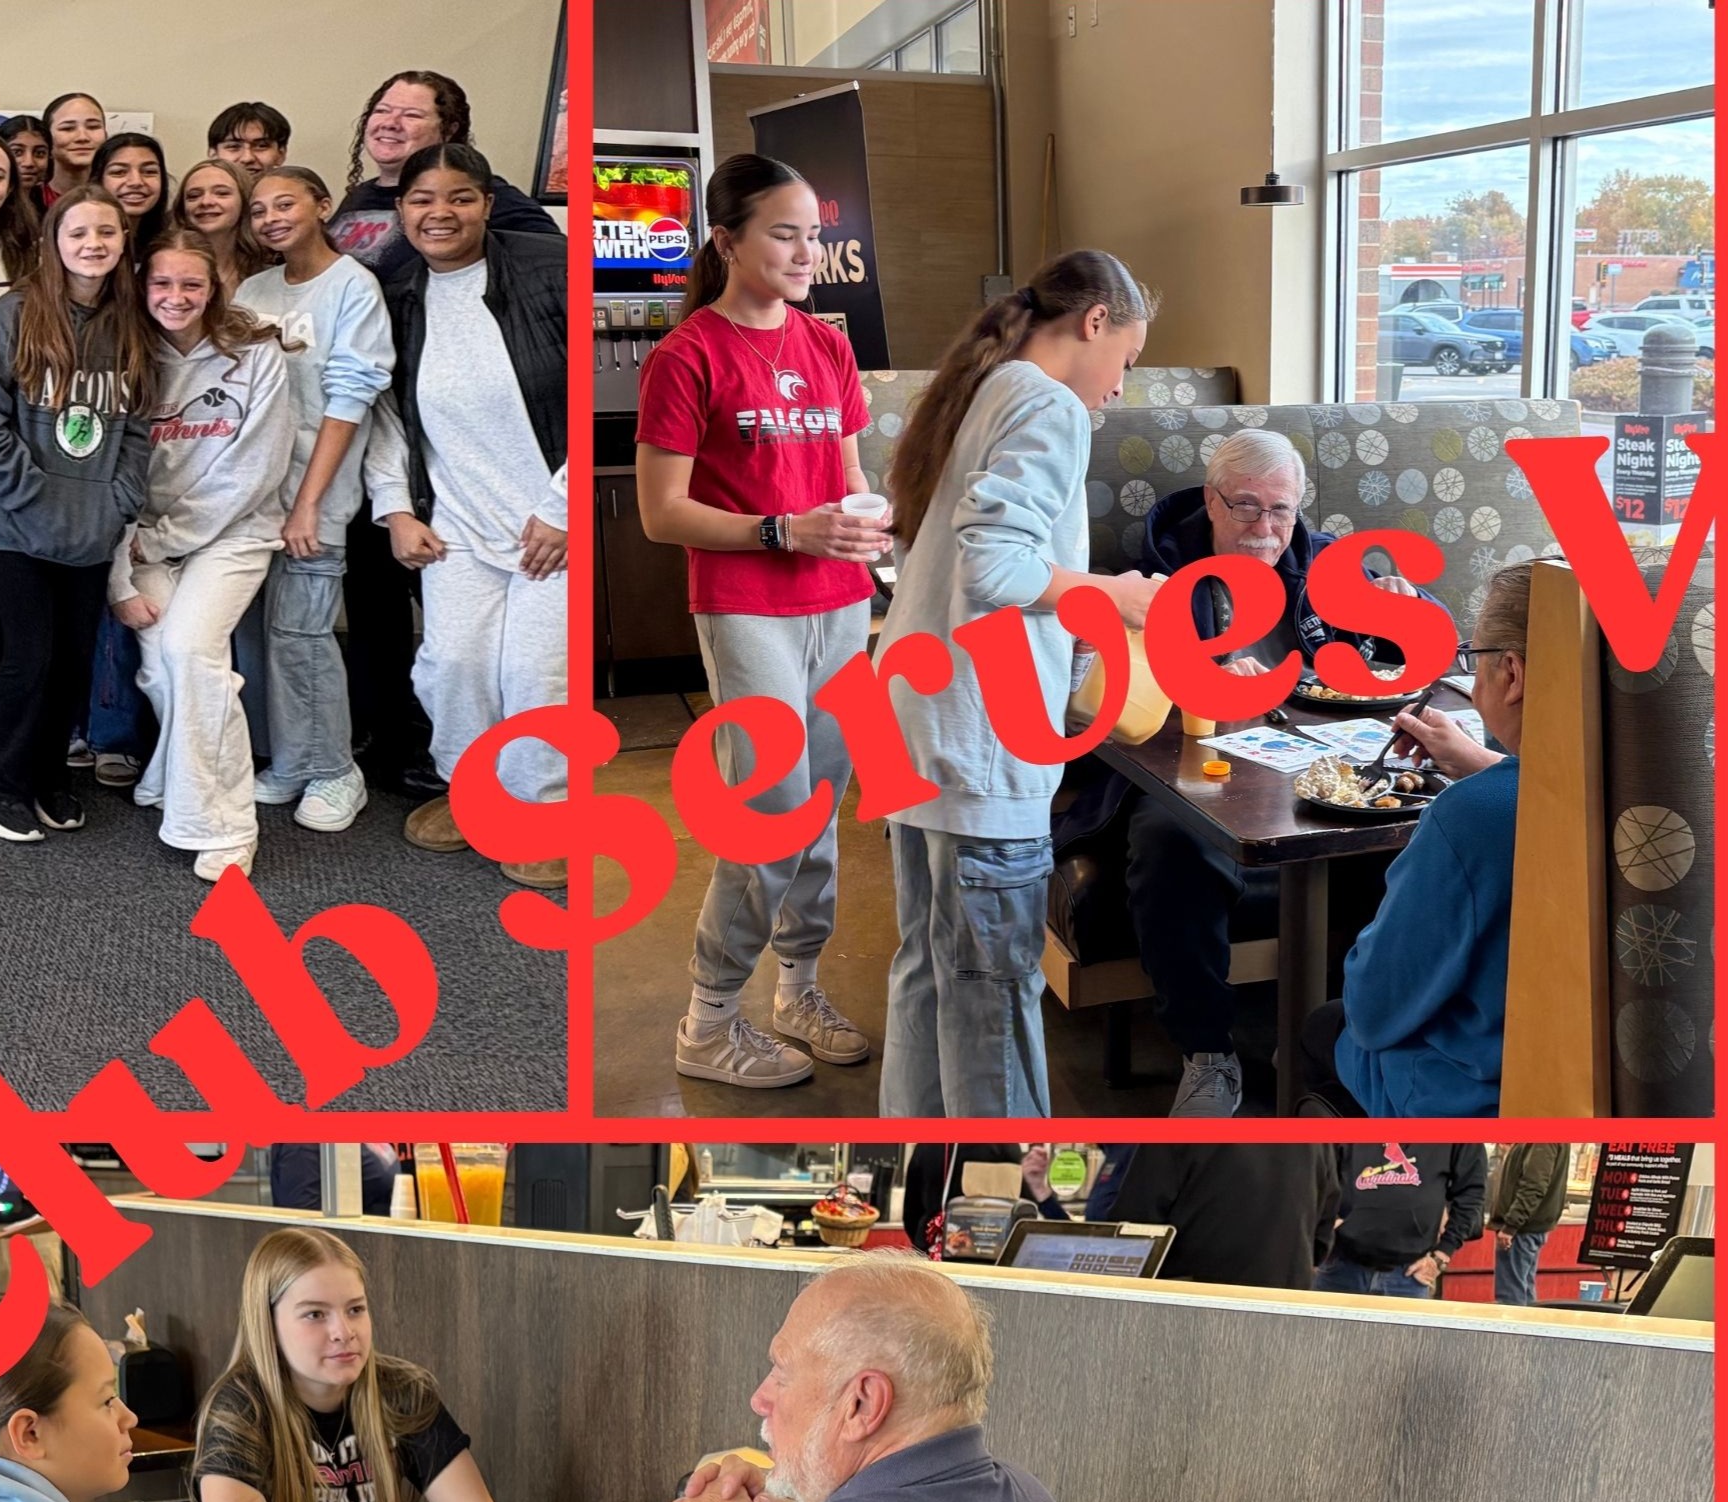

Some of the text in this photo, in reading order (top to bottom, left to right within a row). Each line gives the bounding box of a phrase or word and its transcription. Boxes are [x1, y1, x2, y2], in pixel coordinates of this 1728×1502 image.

[334, 219, 390, 251] FMS
[649, 234, 688, 245] PEPSI
[593, 238, 650, 259] WITH
[652, 273, 688, 286] HyVee
[736, 407, 843, 437] FALCON
[1616, 437, 1656, 453] Steak
[1666, 437, 1687, 453] Ste
[1616, 452, 1656, 470] Night
[1616, 497, 1645, 520] $12
[1355, 1171, 1422, 1190] Cardinals
